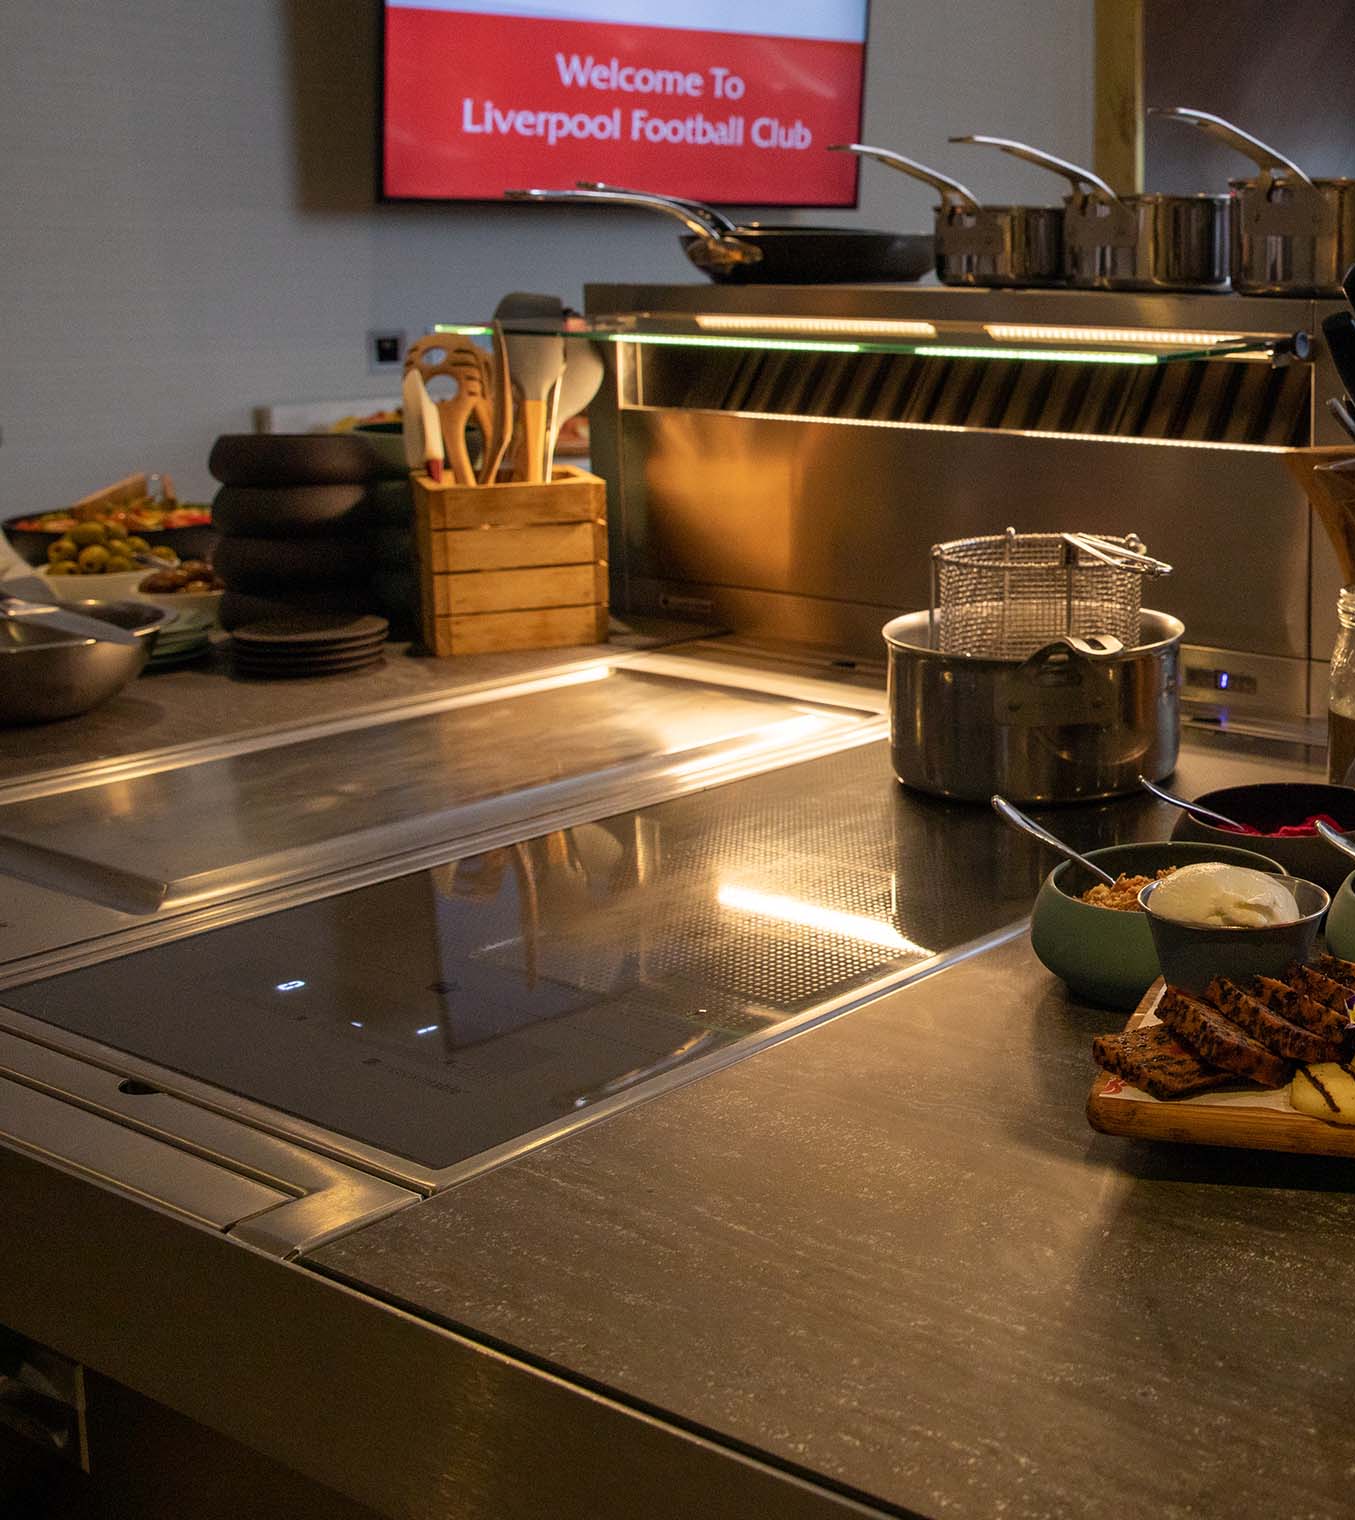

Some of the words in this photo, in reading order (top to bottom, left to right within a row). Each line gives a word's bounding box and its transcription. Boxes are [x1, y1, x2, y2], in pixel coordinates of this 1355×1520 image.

[556, 52, 702, 96] Welcome
[709, 67, 745, 99] To
[462, 98, 621, 145] Liverpool
[630, 110, 744, 146] Football
[751, 118, 812, 150] Club
